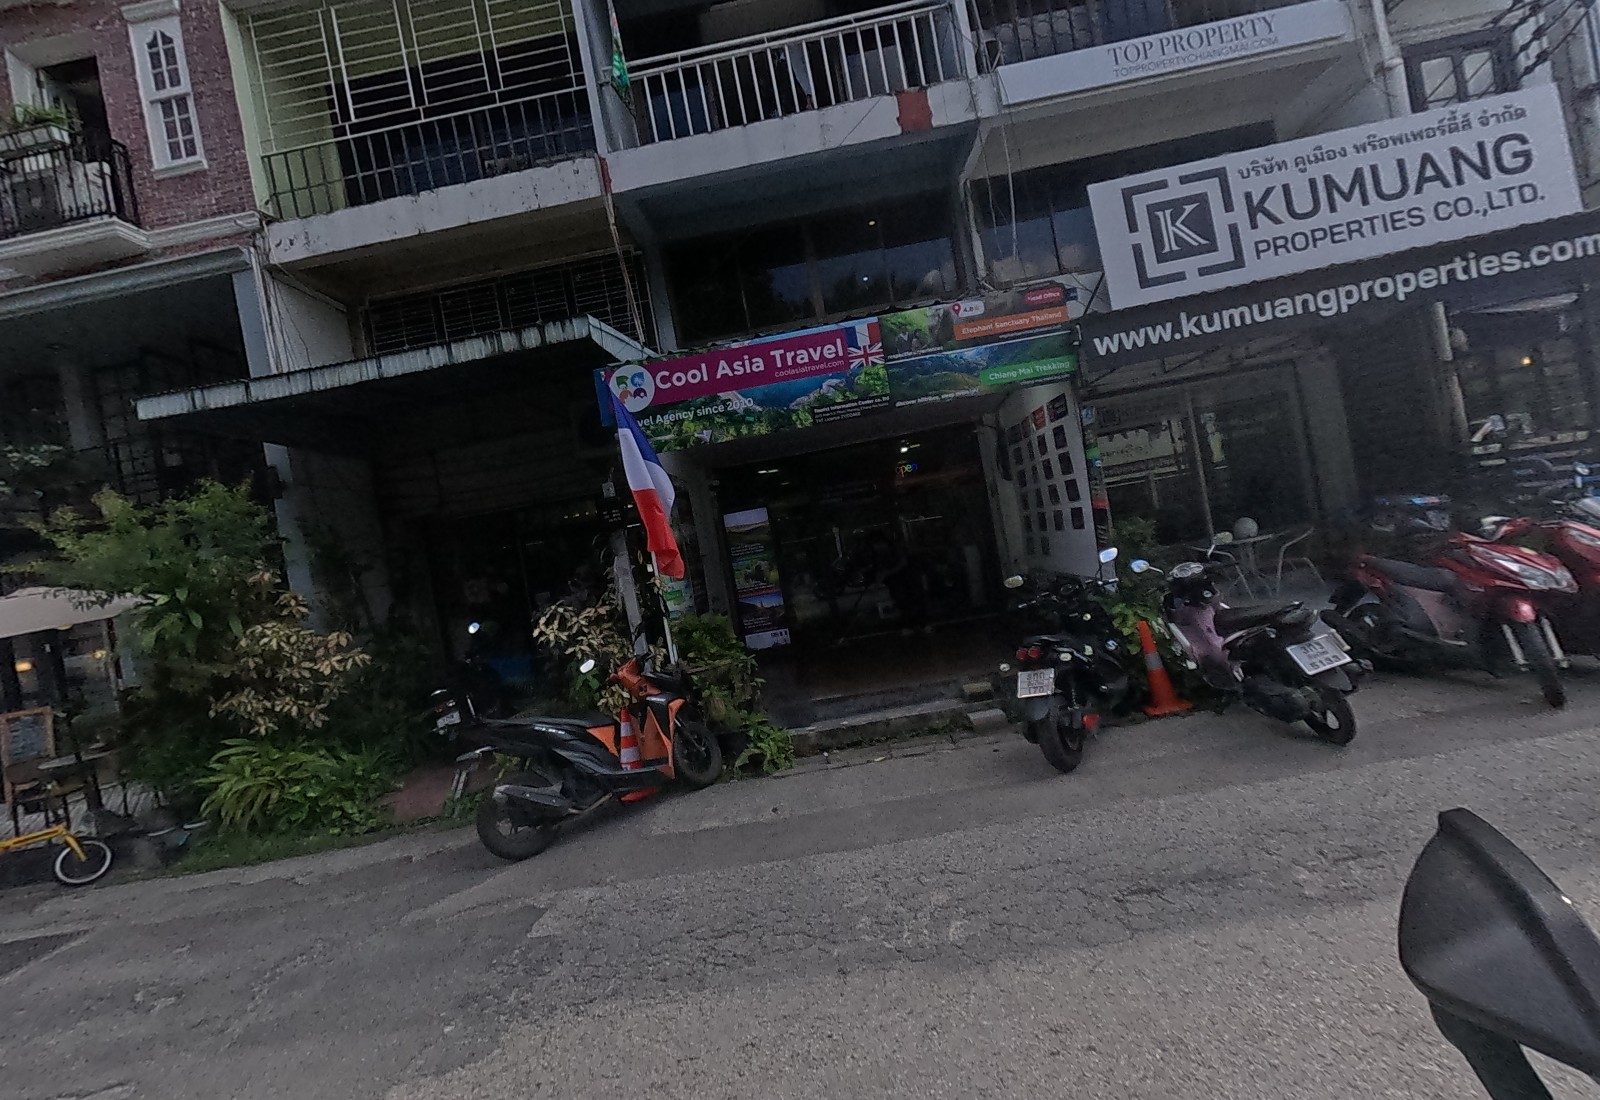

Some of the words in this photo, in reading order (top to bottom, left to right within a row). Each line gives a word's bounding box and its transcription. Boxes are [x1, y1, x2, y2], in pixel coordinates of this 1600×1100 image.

[1107, 40, 1153, 66] TOP
[1159, 14, 1276, 56] PROPERTY
[1238, 156, 1288, 180] บริษัท
[1294, 144, 1348, 174] คูเมือง
[1477, 103, 1528, 128] จำกัด
[1244, 132, 1534, 230] KUMUANG
[1153, 202, 1211, 254] K
[1254, 206, 1426, 260] PROPERTIES
[1433, 182, 1546, 222] CO.,LTD.
[1093, 230, 1600, 356] www.kumuangproperties.com
[994, 317, 1030, 330] Sanctuary
[1032, 311, 1062, 322] Thailand
[655, 362, 709, 390] Cool
[716, 354, 765, 379] Asia
[769, 338, 844, 368] Travel
[774, 359, 845, 378] coolasiatravel.com
[989, 370, 1017, 382] Chiang
[1018, 367, 1033, 378] Mai
[1035, 360, 1070, 374] Trekking
[637, 416, 653, 427] vel
[656, 409, 695, 426] Agency
[696, 404, 725, 416] since
[726, 397, 754, 411] 2010
